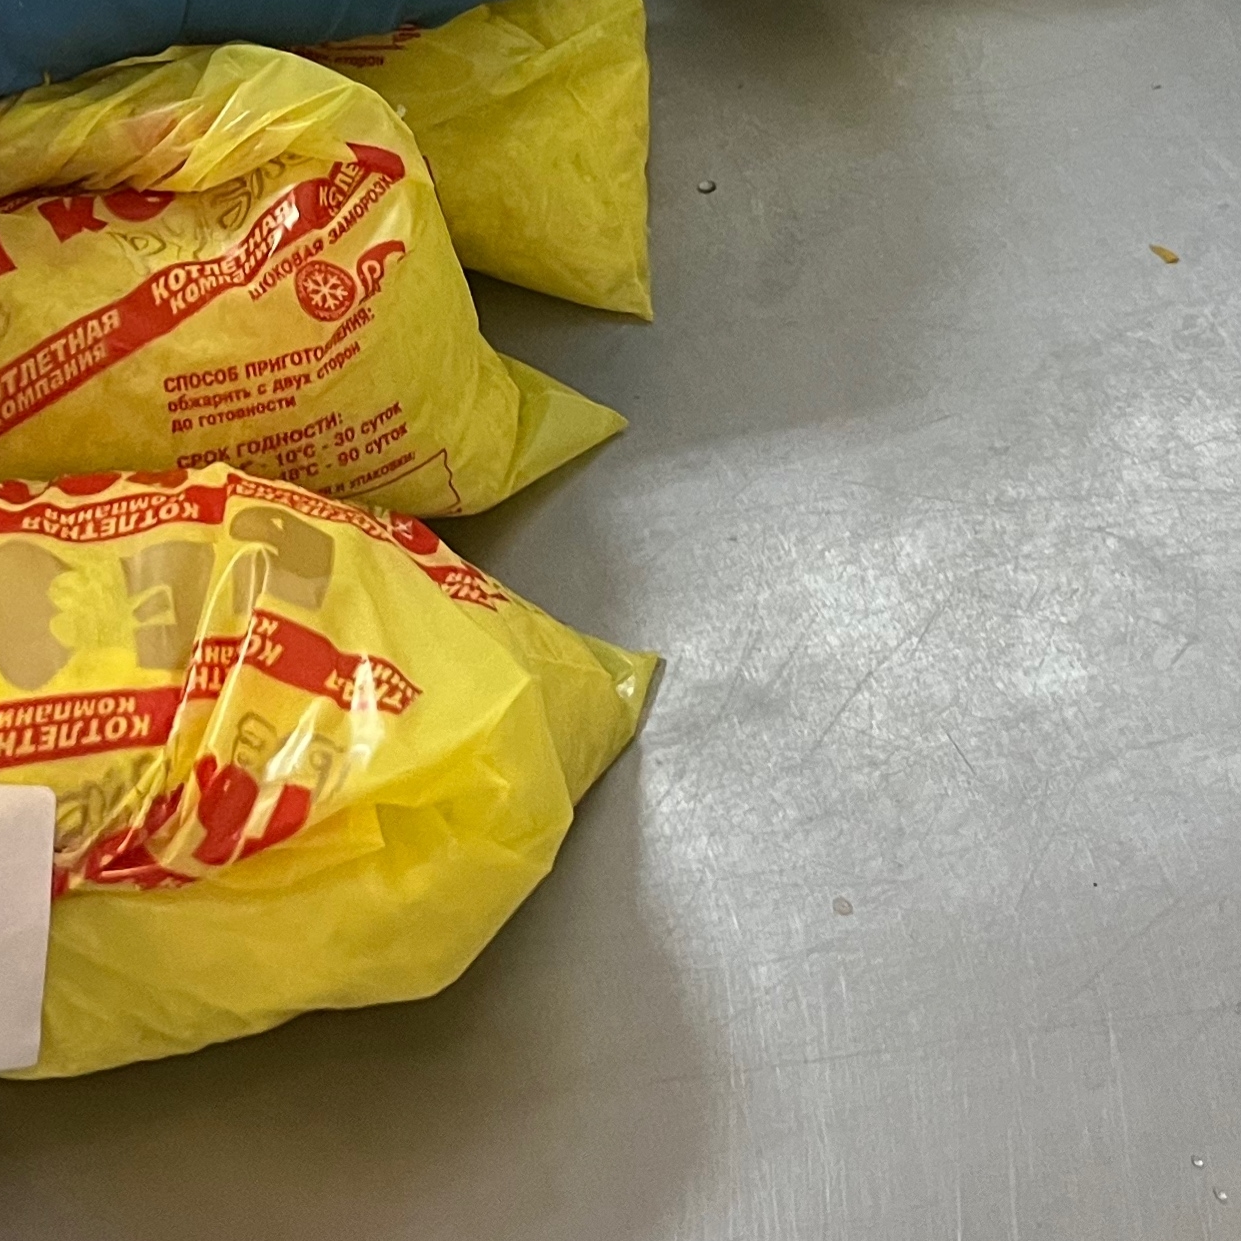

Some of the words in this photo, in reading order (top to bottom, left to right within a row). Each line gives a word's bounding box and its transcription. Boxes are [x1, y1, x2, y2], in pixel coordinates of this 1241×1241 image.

[150, 193, 298, 307] КОТЛЕТНАЯ
[248, 237, 324, 302] ШОКОВАЯ
[327, 174, 394, 246] ЗАМОРОЗК
[164, 365, 239, 393] СПОСОБ
[168, 387, 251, 412] обжарить
[273, 373, 312, 394] двух
[317, 340, 361, 380] сторон
[171, 417, 193, 434] до
[198, 395, 297, 429] готовности
[334, 426, 356, 447] 30
[360, 401, 403, 436] суток
[176, 446, 231, 471] СРОК
[236, 412, 344, 458] ГОДНОСТИ:
[365, 421, 409, 455] суток
[20, 502, 201, 543] КОТЛЕТНАЯ
